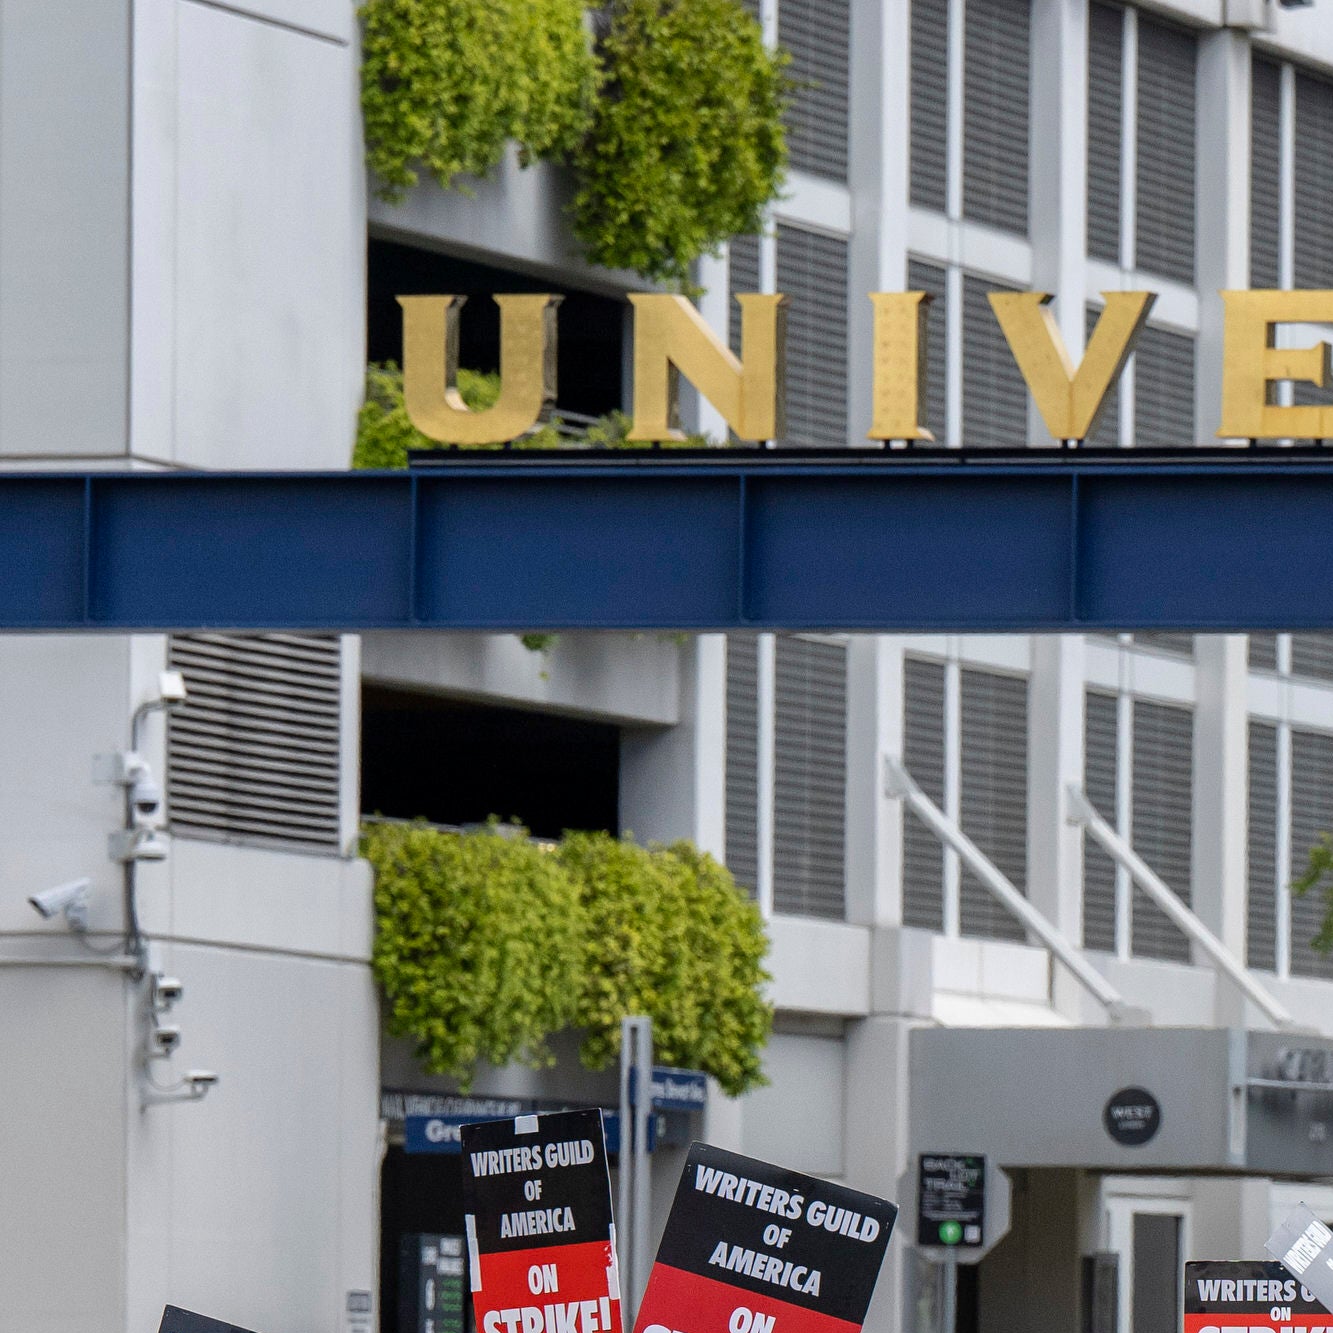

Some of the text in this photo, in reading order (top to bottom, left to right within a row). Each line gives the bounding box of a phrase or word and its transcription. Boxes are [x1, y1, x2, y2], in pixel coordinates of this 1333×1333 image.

[470, 1139, 595, 1178] WRITERS GUILD
[524, 1180, 542, 1201] OF
[694, 1164, 804, 1221] WRITERS
[806, 1200, 880, 1243] GUILD
[500, 1206, 576, 1239] AMERICA
[762, 1224, 793, 1249] OF
[527, 1263, 559, 1295] ON
[708, 1241, 821, 1297] AMERICA
[1197, 1279, 1296, 1302] WRITERS
[1270, 1307, 1291, 1322] ON
